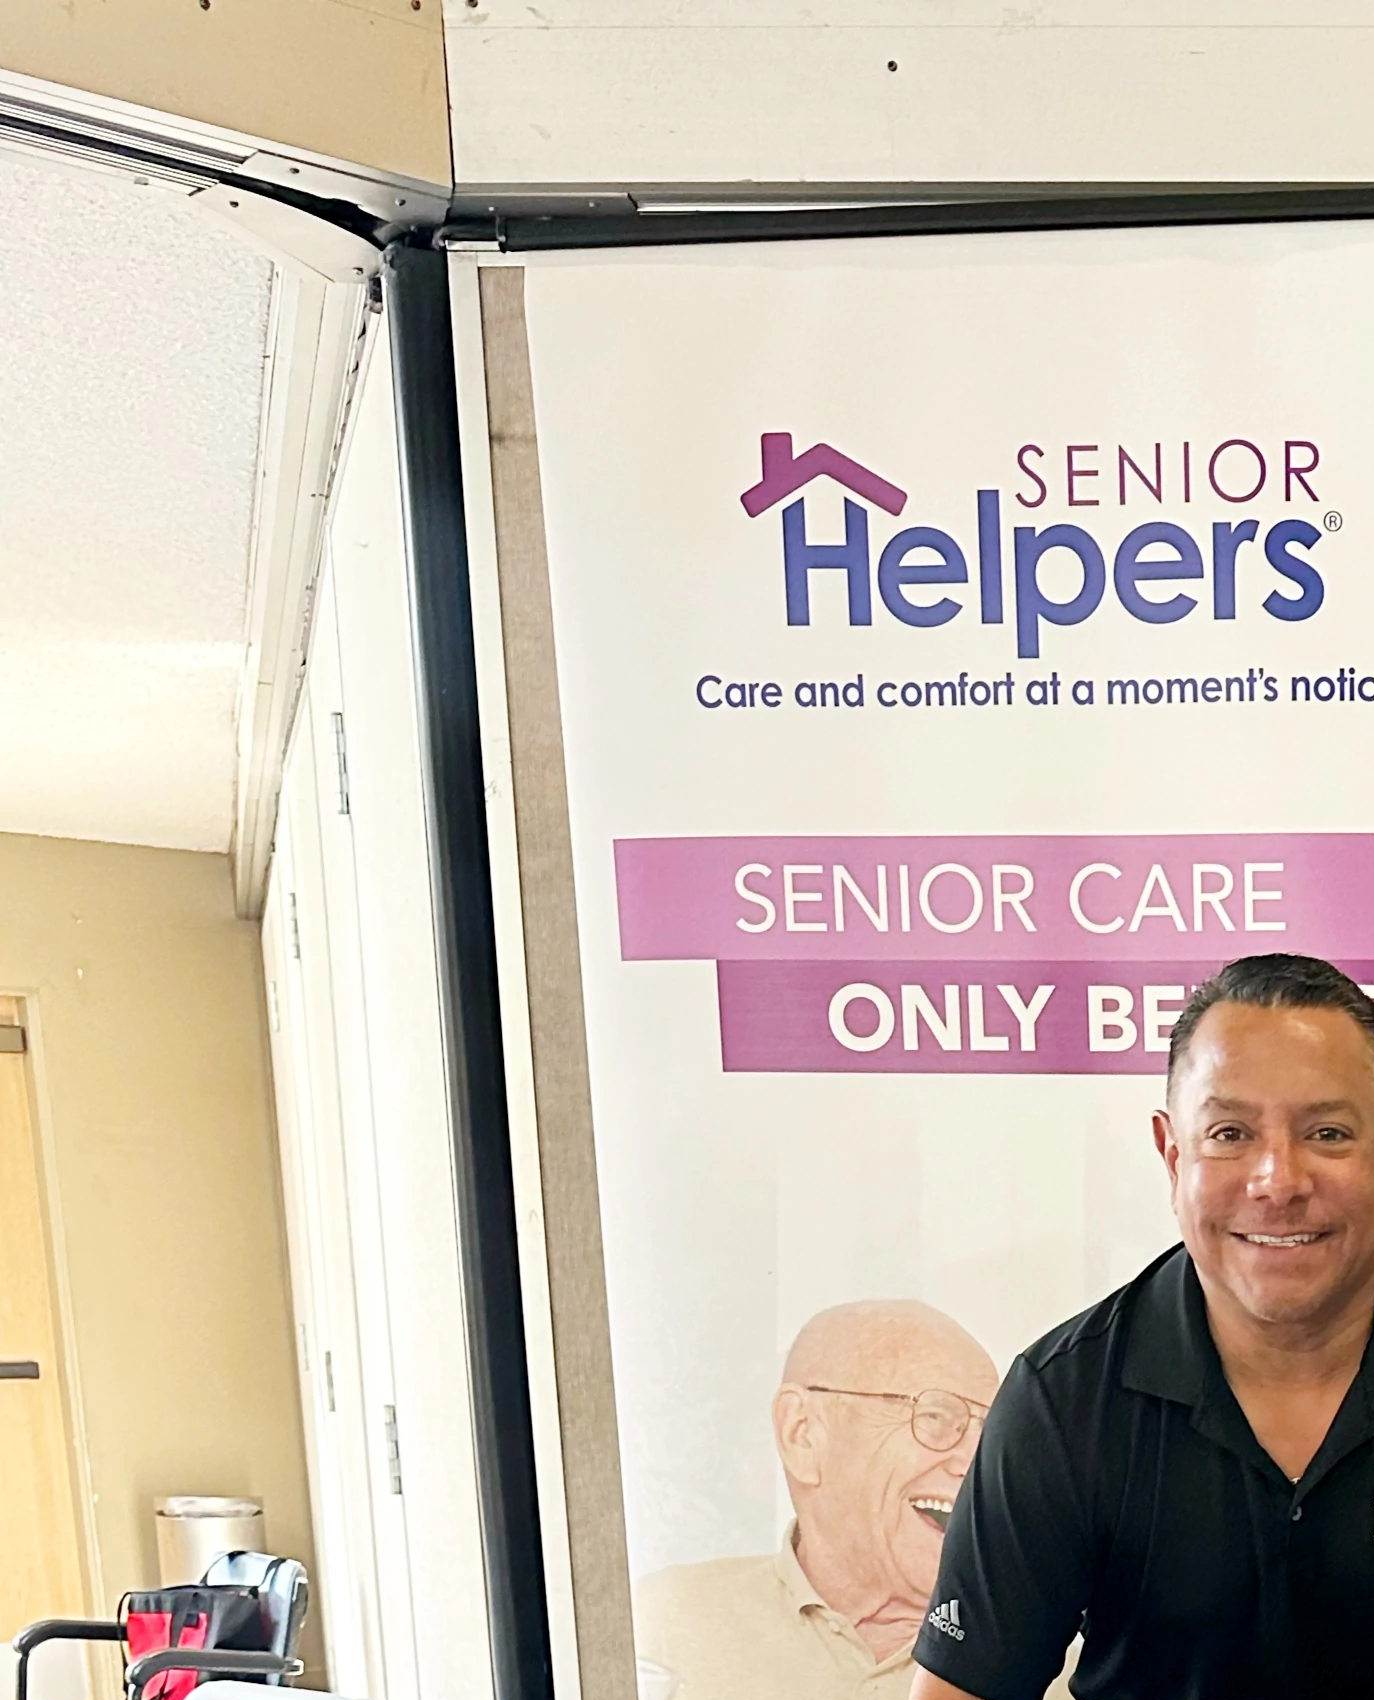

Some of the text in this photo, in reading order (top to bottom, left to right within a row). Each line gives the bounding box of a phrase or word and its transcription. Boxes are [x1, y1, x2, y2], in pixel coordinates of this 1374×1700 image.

[1016, 439, 1321, 508] SENIOR
[696, 675, 783, 711] Care
[795, 675, 865, 710] and
[876, 673, 1015, 710] comfort
[1026, 674, 1060, 708] at
[1072, 681, 1095, 707] a
[1107, 669, 1278, 706] moment's
[735, 862, 1286, 934] SENIOR CARE
[827, 983, 1055, 1053] ONLY
